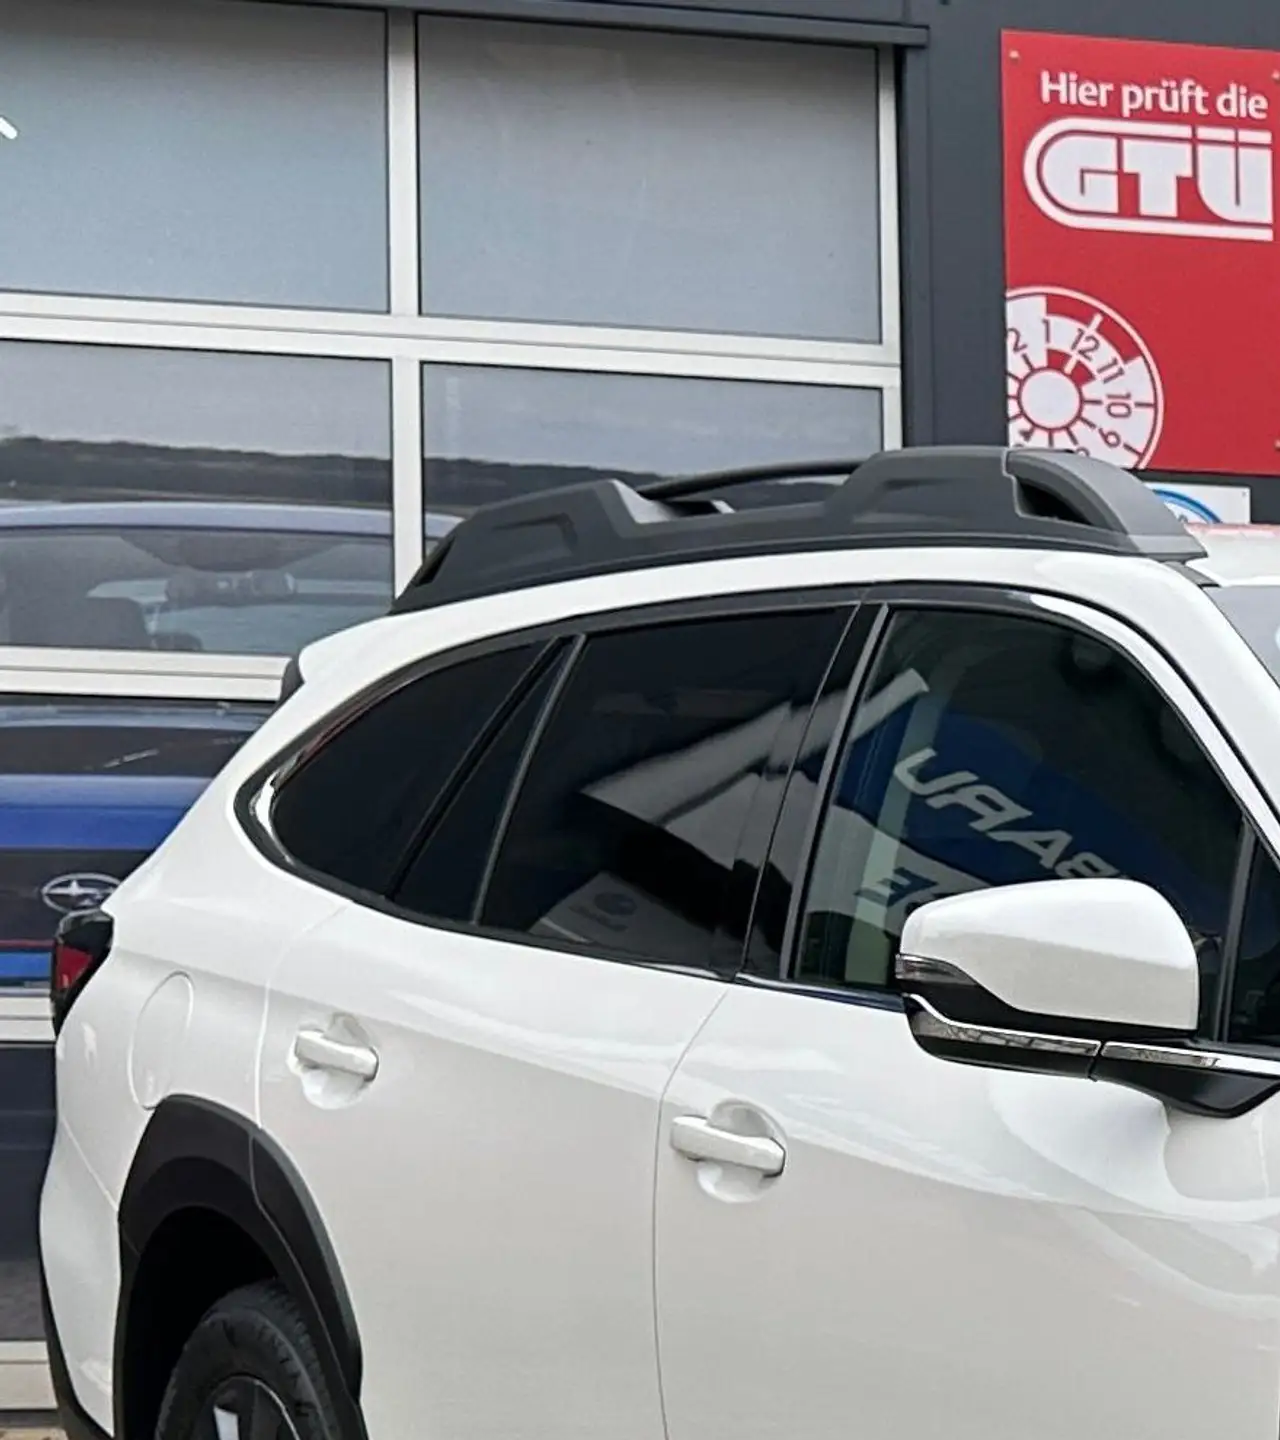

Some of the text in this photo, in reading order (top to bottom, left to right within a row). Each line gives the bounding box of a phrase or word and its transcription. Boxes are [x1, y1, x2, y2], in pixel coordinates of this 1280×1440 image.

[1041, 70, 1269, 119] Hier prüft die
[1034, 122, 1274, 232] GTÜ
[1042, 318, 1051, 344] 1
[1071, 328, 1100, 362] 12
[1097, 356, 1125, 384] 11
[1107, 392, 1132, 419] 10
